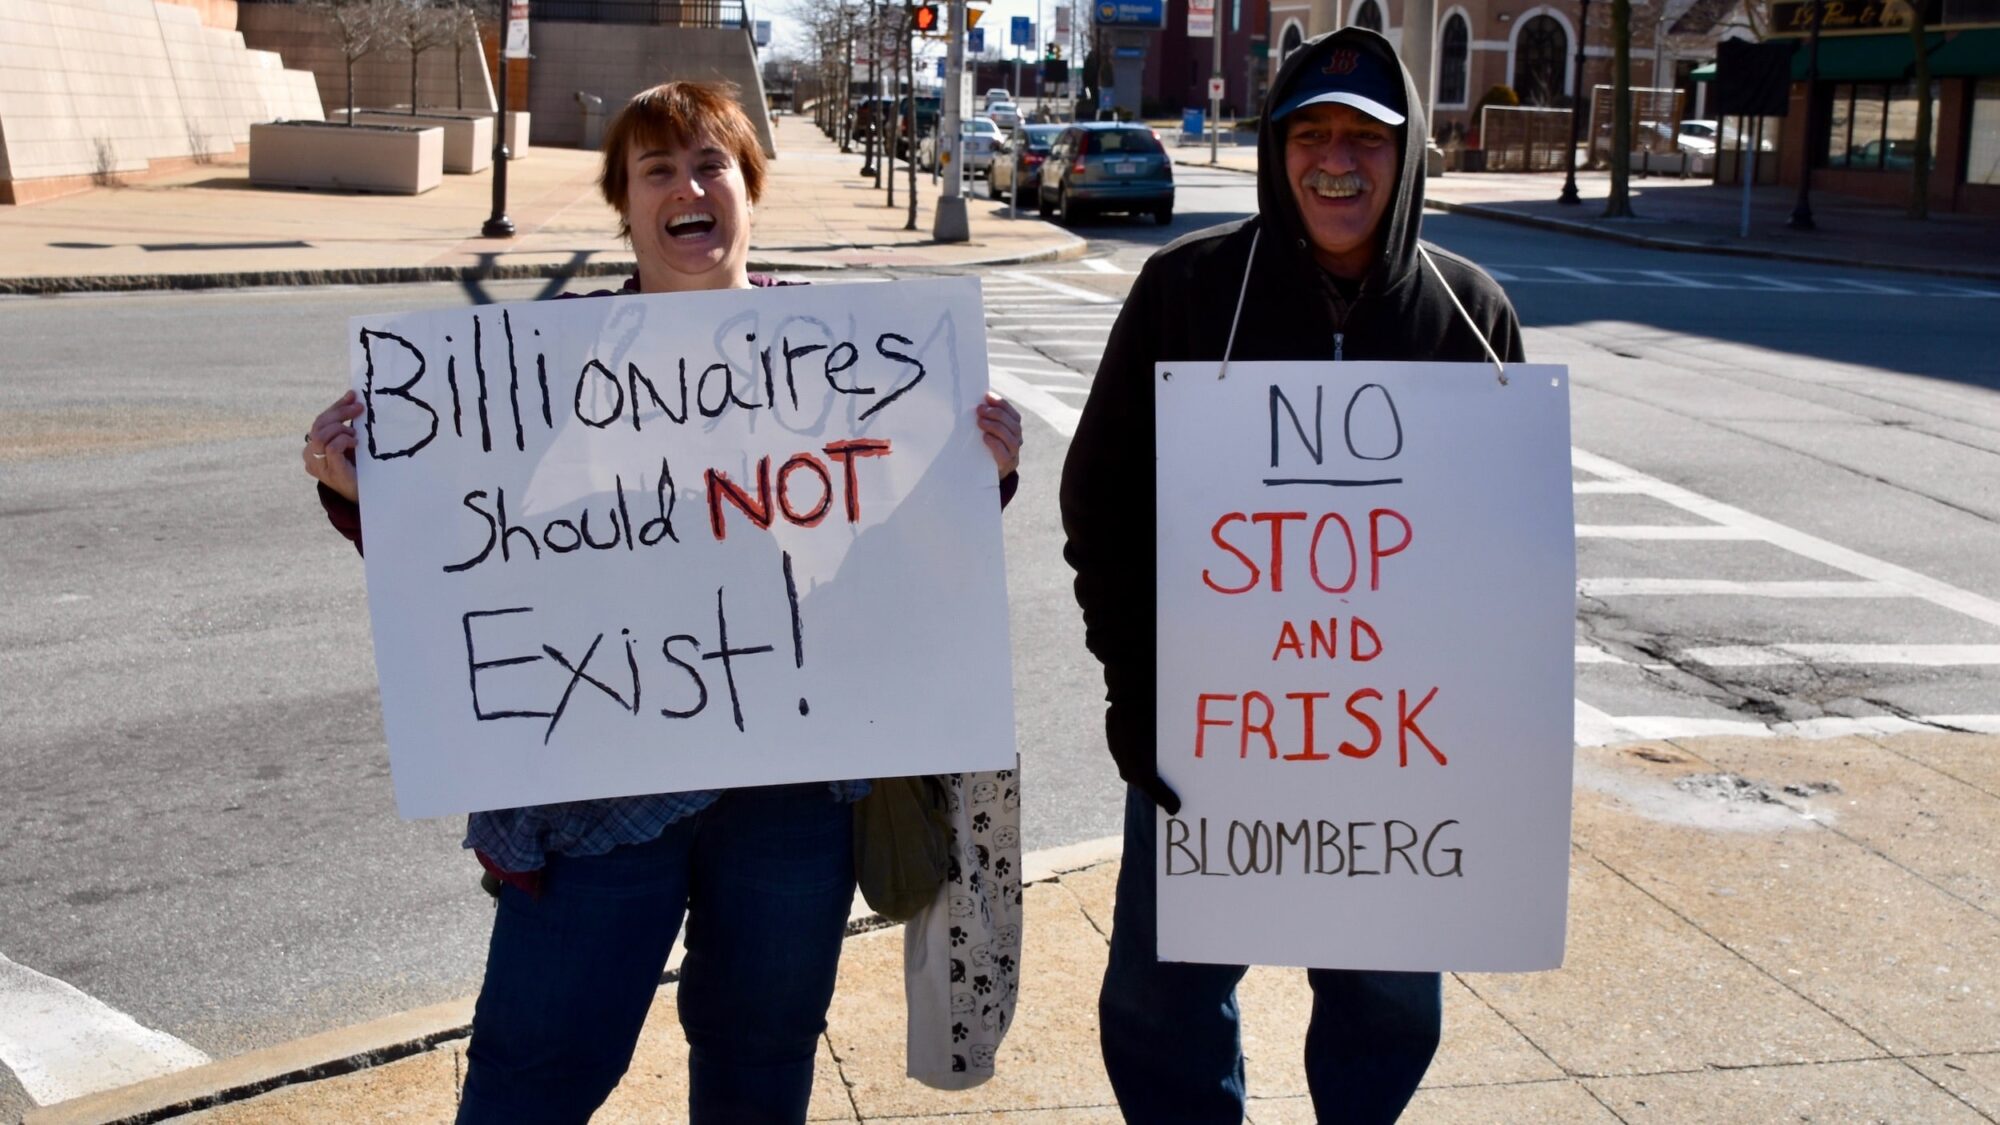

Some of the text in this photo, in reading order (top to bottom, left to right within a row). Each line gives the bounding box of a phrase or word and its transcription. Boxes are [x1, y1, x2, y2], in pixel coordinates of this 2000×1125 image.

[360, 308, 927, 462] Billionaires
[1269, 384, 1403, 468] NO
[443, 438, 893, 573] Should NOT
[1202, 508, 1412, 595] STOP
[462, 550, 811, 746] Exist!
[1272, 617, 1384, 662] AND
[1194, 687, 1448, 768] FRISK
[1165, 815, 1464, 878] BLOOMBERG
